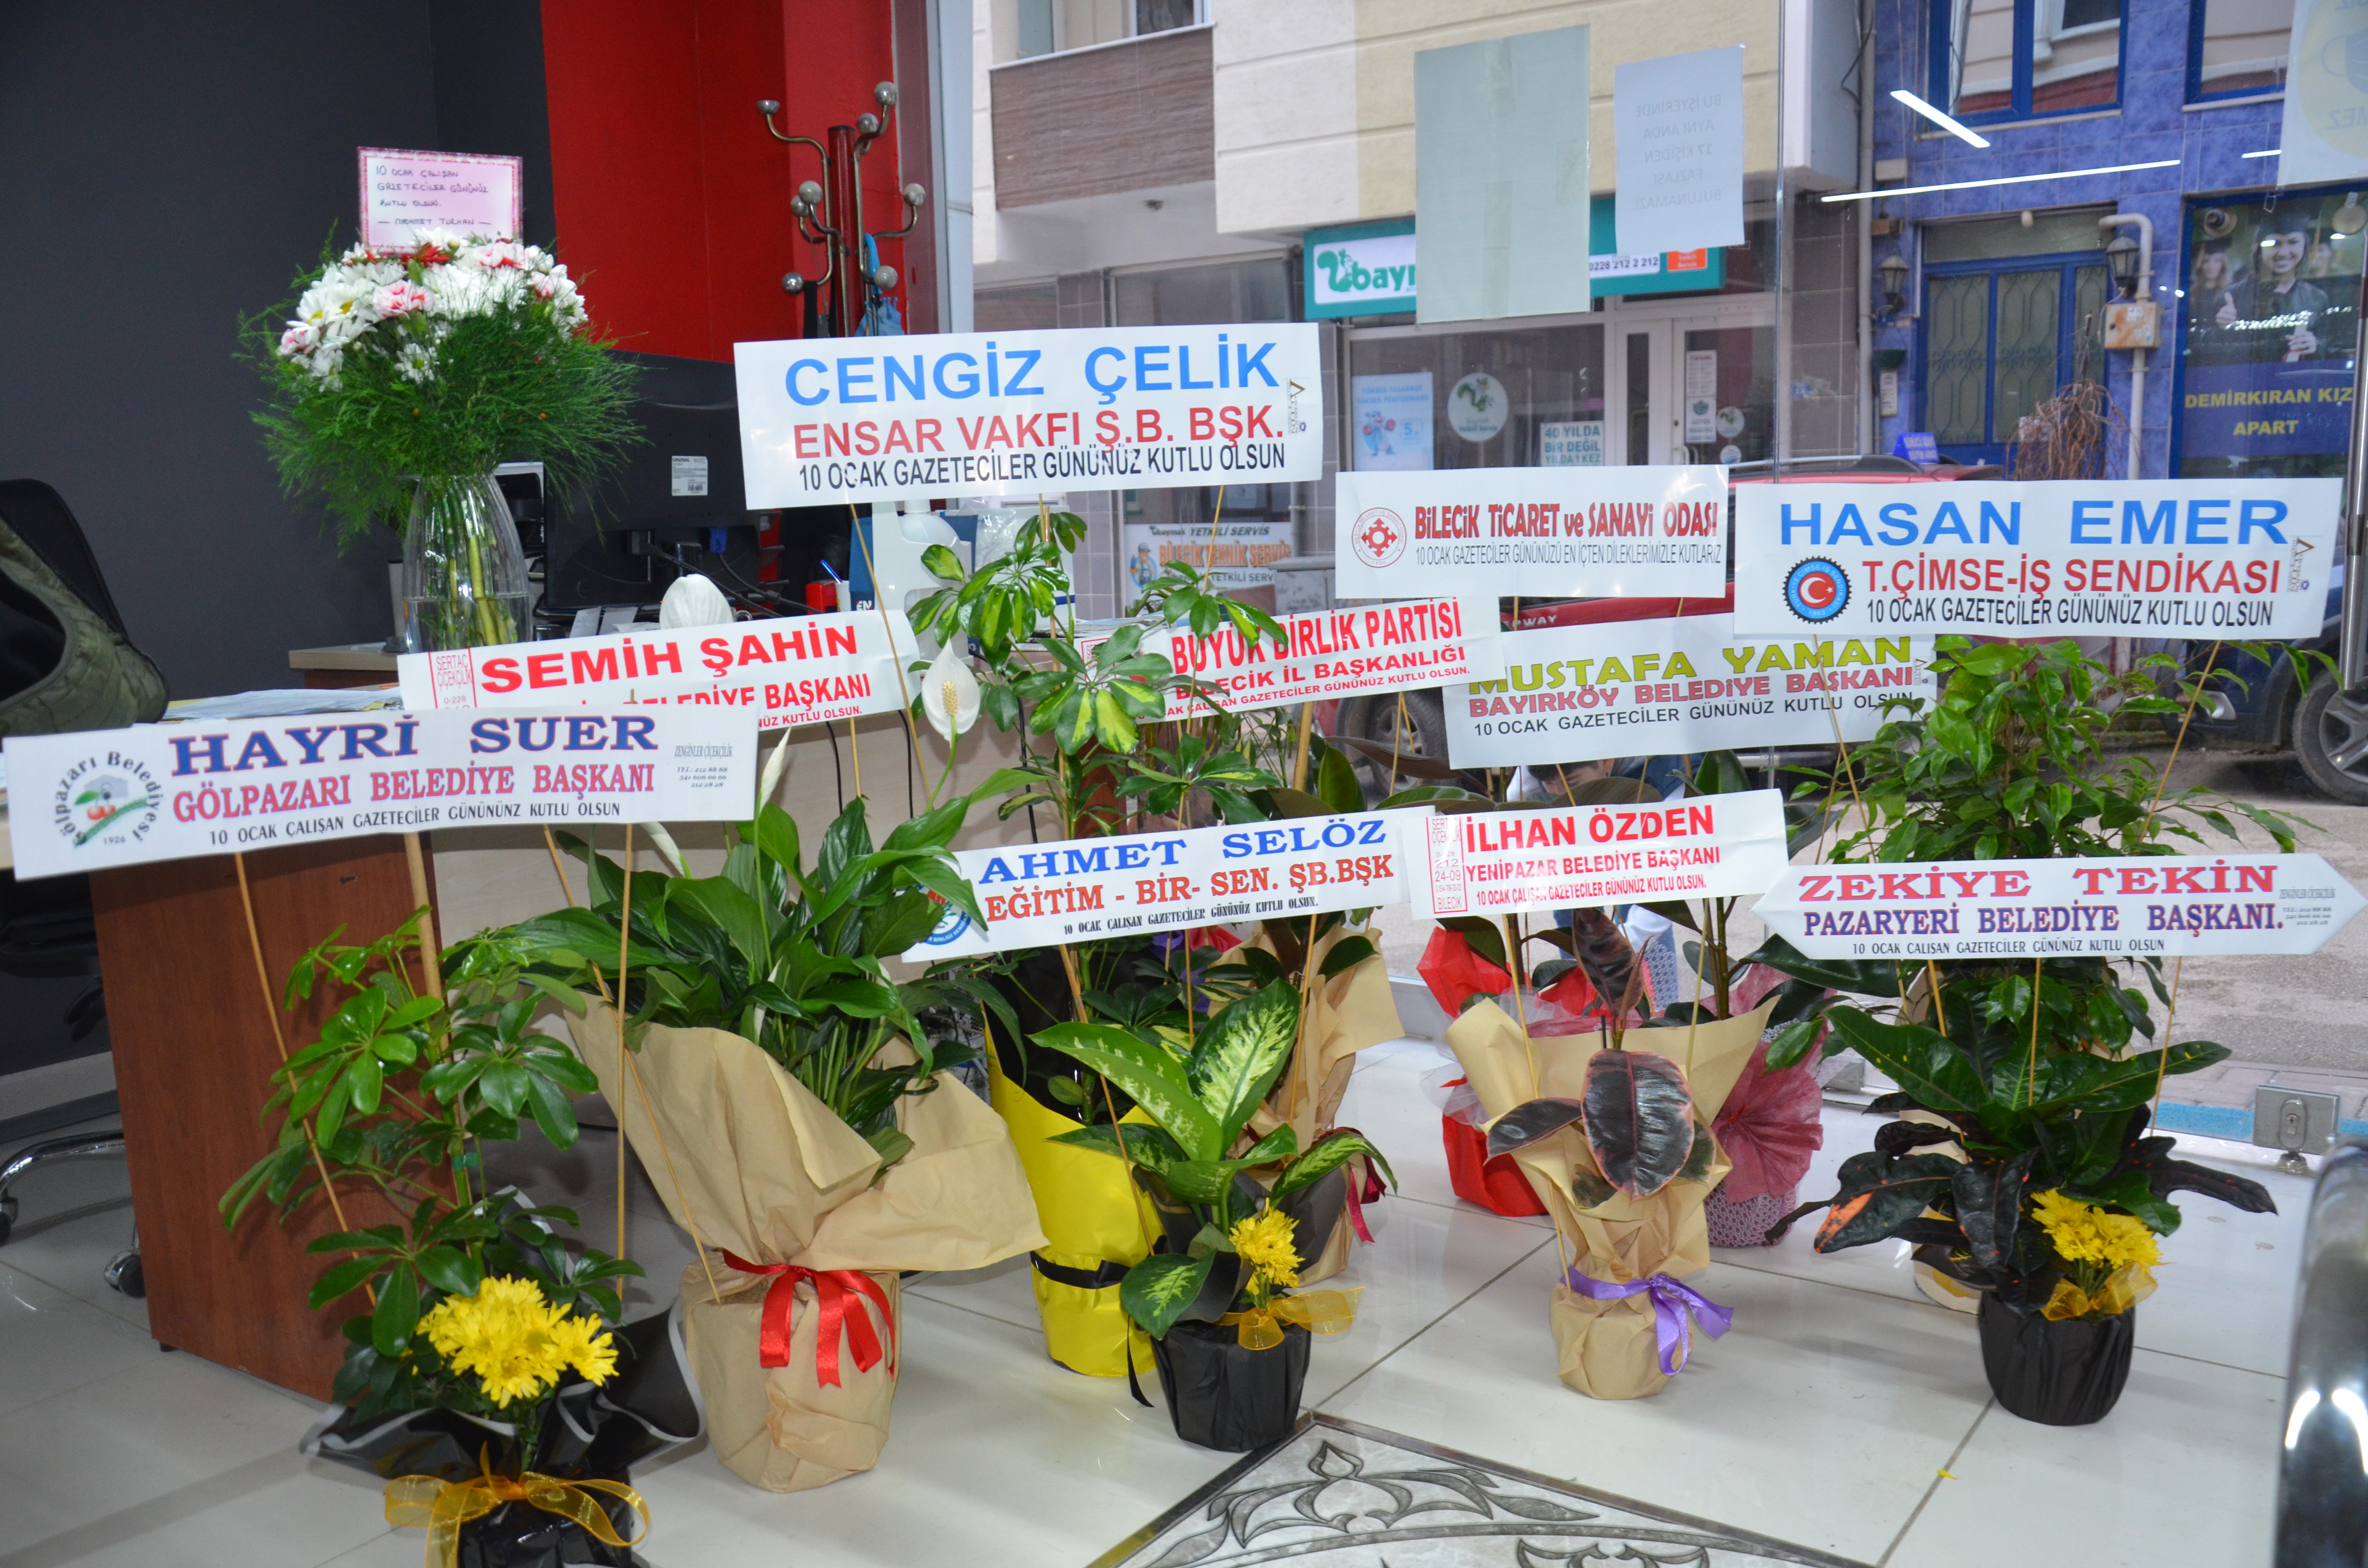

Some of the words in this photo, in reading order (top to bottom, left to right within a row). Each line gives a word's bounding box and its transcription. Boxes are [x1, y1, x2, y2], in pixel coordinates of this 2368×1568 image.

[376, 166, 386, 175] 10
[1633, 258, 1638, 267] 2
[1642, 257, 1658, 267] 212
[786, 341, 1044, 406] CENGİZ
[1085, 333, 1280, 405] ÇELİK
[2185, 388, 2311, 409] DEMİRKIRAN
[2318, 387, 2354, 402] KIZ
[794, 418, 945, 459] ENSAR
[956, 412, 1080, 451] VAKFI
[1096, 409, 1173, 453] Ş.B.
[1189, 405, 1283, 448] BŞK.
[1545, 427, 1559, 438] 40
[1564, 425, 1600, 437] YILDA
[2233, 419, 2299, 436] APART
[800, 464, 820, 490] 10
[828, 460, 888, 489] OCAK
[894, 448, 1037, 486] GAZETECİLER
[1044, 443, 1141, 478] GÜNÜNÜZ
[1147, 446, 1212, 473] KUTLU
[1220, 443, 1284, 470] OLSUN
[1582, 453, 1601, 462] KEZ
[1564, 512, 1584, 537] ve
[1664, 502, 1718, 537] ODASI
[1781, 501, 2021, 546] HASAN
[2070, 500, 2288, 544] EMER
[1205, 539, 1248, 567] TEKNİK
[1417, 547, 1425, 565] 10
[1428, 545, 1451, 565] OCAK
[1454, 541, 1510, 564] GAZETECİLER
[1513, 541, 1561, 563] GÜNÜNÜZÜ
[1564, 544, 1575, 563] EN
[1579, 541, 1604, 567] İÇTEN
[1679, 544, 1721, 563] KUTLARIZ
[2064, 552, 2280, 594] SENDİKASI
[1365, 597, 1461, 648] PARTİSİ
[1867, 599, 1884, 623] 10
[1890, 598, 1936, 623] OCAK
[1942, 595, 2052, 625] GAZETECİLER
[2058, 593, 2142, 624] GÜNÜNÜZ
[2148, 600, 2206, 625] KUTLU
[2213, 600, 2273, 626] OLSUN
[436, 654, 468, 672] SERTAÇ
[481, 637, 682, 693] SEMİH
[700, 622, 857, 677] ŞAHİN
[1283, 665, 1306, 683] İL
[1314, 644, 1465, 678] BAŞKANLIĞI
[1468, 651, 1697, 695] MUSTAFA
[1722, 637, 1910, 674] YAMAN
[444, 696, 466, 704] 0-228
[765, 673, 871, 711] BAŞKANI
[1241, 685, 1320, 703] GAZETECİLER
[1324, 677, 1384, 691] GÜNÜNÜZ
[1388, 672, 1425, 683] KUTLU
[1430, 667, 1469, 678] OLSUN.
[1469, 684, 1619, 717] BAYIRKÖY
[1787, 667, 1912, 692] BAŞKANI
[782, 712, 820, 724] KUTLU
[824, 705, 863, 719] OLSUN.
[1474, 723, 1492, 736] 10
[1498, 719, 1548, 735] OCAK
[1558, 707, 1679, 730] GAZETECİLER
[1690, 700, 1774, 720] GÜNÜNÜZ
[1784, 696, 1842, 712] KUTLU
[168, 714, 419, 777] HAYRİ
[469, 715, 658, 754] SUER
[173, 774, 351, 823] GÖLPAZARI
[370, 760, 515, 801] BELEDİYE
[533, 763, 654, 800] BAŞKANI
[104, 835, 126, 844] 1926
[210, 831, 228, 845] 10
[238, 825, 277, 842] OCAK
[286, 816, 343, 838] ÇALIŞAN
[353, 806, 439, 828] GAZETECİLER
[530, 803, 569, 816] KUTLU
[578, 803, 620, 816] OLSUN
[1466, 816, 1576, 853] İLHAN
[1589, 805, 1714, 843] ÖZDEN
[978, 839, 1186, 884] AHMET
[1222, 818, 1386, 859] SELÖZ
[1466, 859, 1558, 882] YENİPAZAR
[1563, 850, 1642, 875] BELEDİYE
[1647, 846, 1720, 870] BAŞKANI
[985, 881, 1104, 922] EĞİTİM
[1211, 867, 1278, 896] SEN.
[1435, 870, 1461, 882] 24-09
[1477, 891, 1485, 906] 10
[1489, 889, 1510, 905] OCAK
[1549, 879, 1603, 900] GAZETECİLER
[1605, 875, 1645, 895] GÜNÜNÜZ
[1647, 877, 1674, 892] KUTLU
[1677, 874, 1706, 890] OLSUN.
[1799, 865, 2032, 901] ZEKİYE
[2072, 859, 2278, 895] TEKİN
[1064, 924, 1073, 935] 10
[1078, 919, 1101, 932] OCAK
[1107, 915, 1142, 931] ÇALIŞAN
[1148, 907, 1206, 925] GAZETECİLER
[1211, 904, 1250, 918] GÜNÜNÜZ
[1256, 900, 1283, 912] KUTLU
[1288, 897, 1318, 909] OLSUN.
[1804, 902, 1959, 936] PAZARYERİ
[1978, 899, 2119, 933] BELEDİYE
[2147, 903, 2283, 937] BAŞKANI.
[1853, 943, 1865, 954] 10
[1872, 943, 1901, 954] OCAK
[1957, 938, 2025, 953] GAZETECİLER
[2033, 937, 2083, 953] GÜNÜNÜZ
[2089, 939, 2122, 951] KUTLU
[2129, 939, 2164, 951] OLSUN
